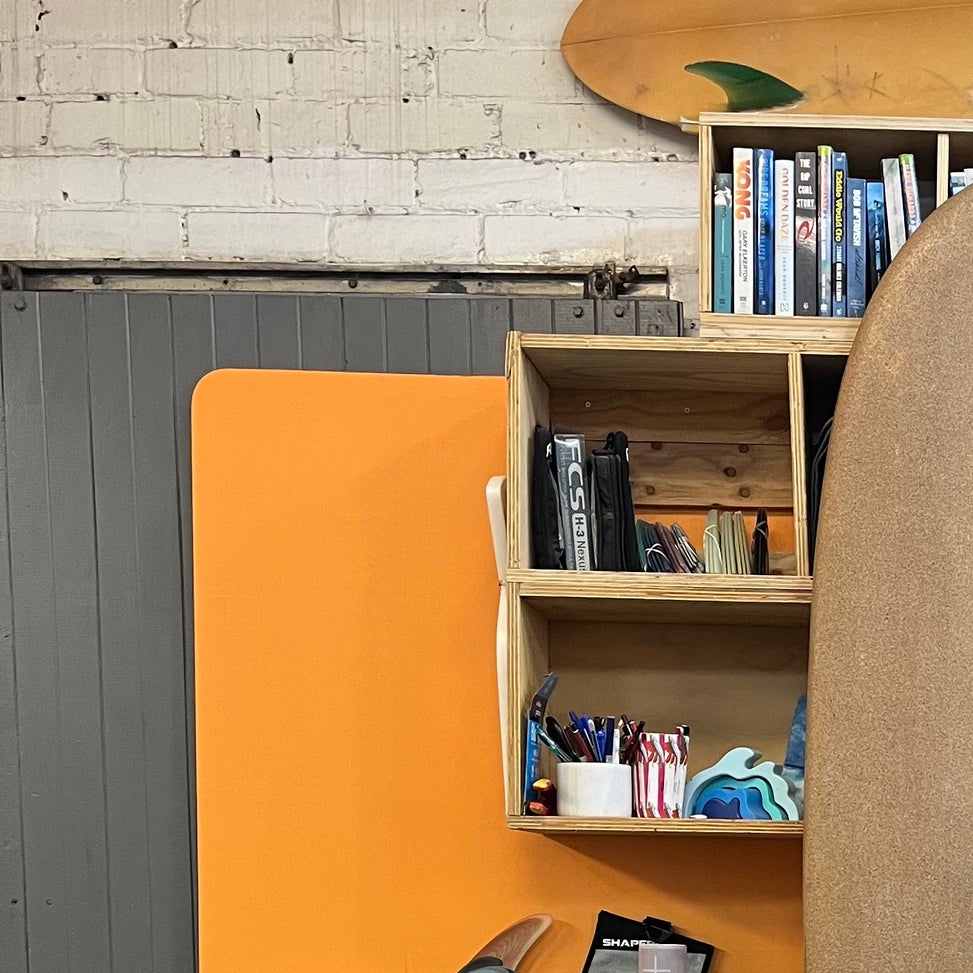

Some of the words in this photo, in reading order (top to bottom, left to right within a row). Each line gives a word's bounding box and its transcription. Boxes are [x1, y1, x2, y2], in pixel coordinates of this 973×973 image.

[799, 158, 811, 169] THE
[735, 160, 751, 220] KONG
[781, 168, 789, 212] GOLDEN
[798, 185, 813, 195] CURL
[835, 171, 843, 197] Eddie
[796, 199, 815, 209] STORY
[835, 198, 843, 227] Would
[835, 229, 843, 242] Go
[567, 439, 585, 510] FCS
[575, 517, 584, 537] H-3
